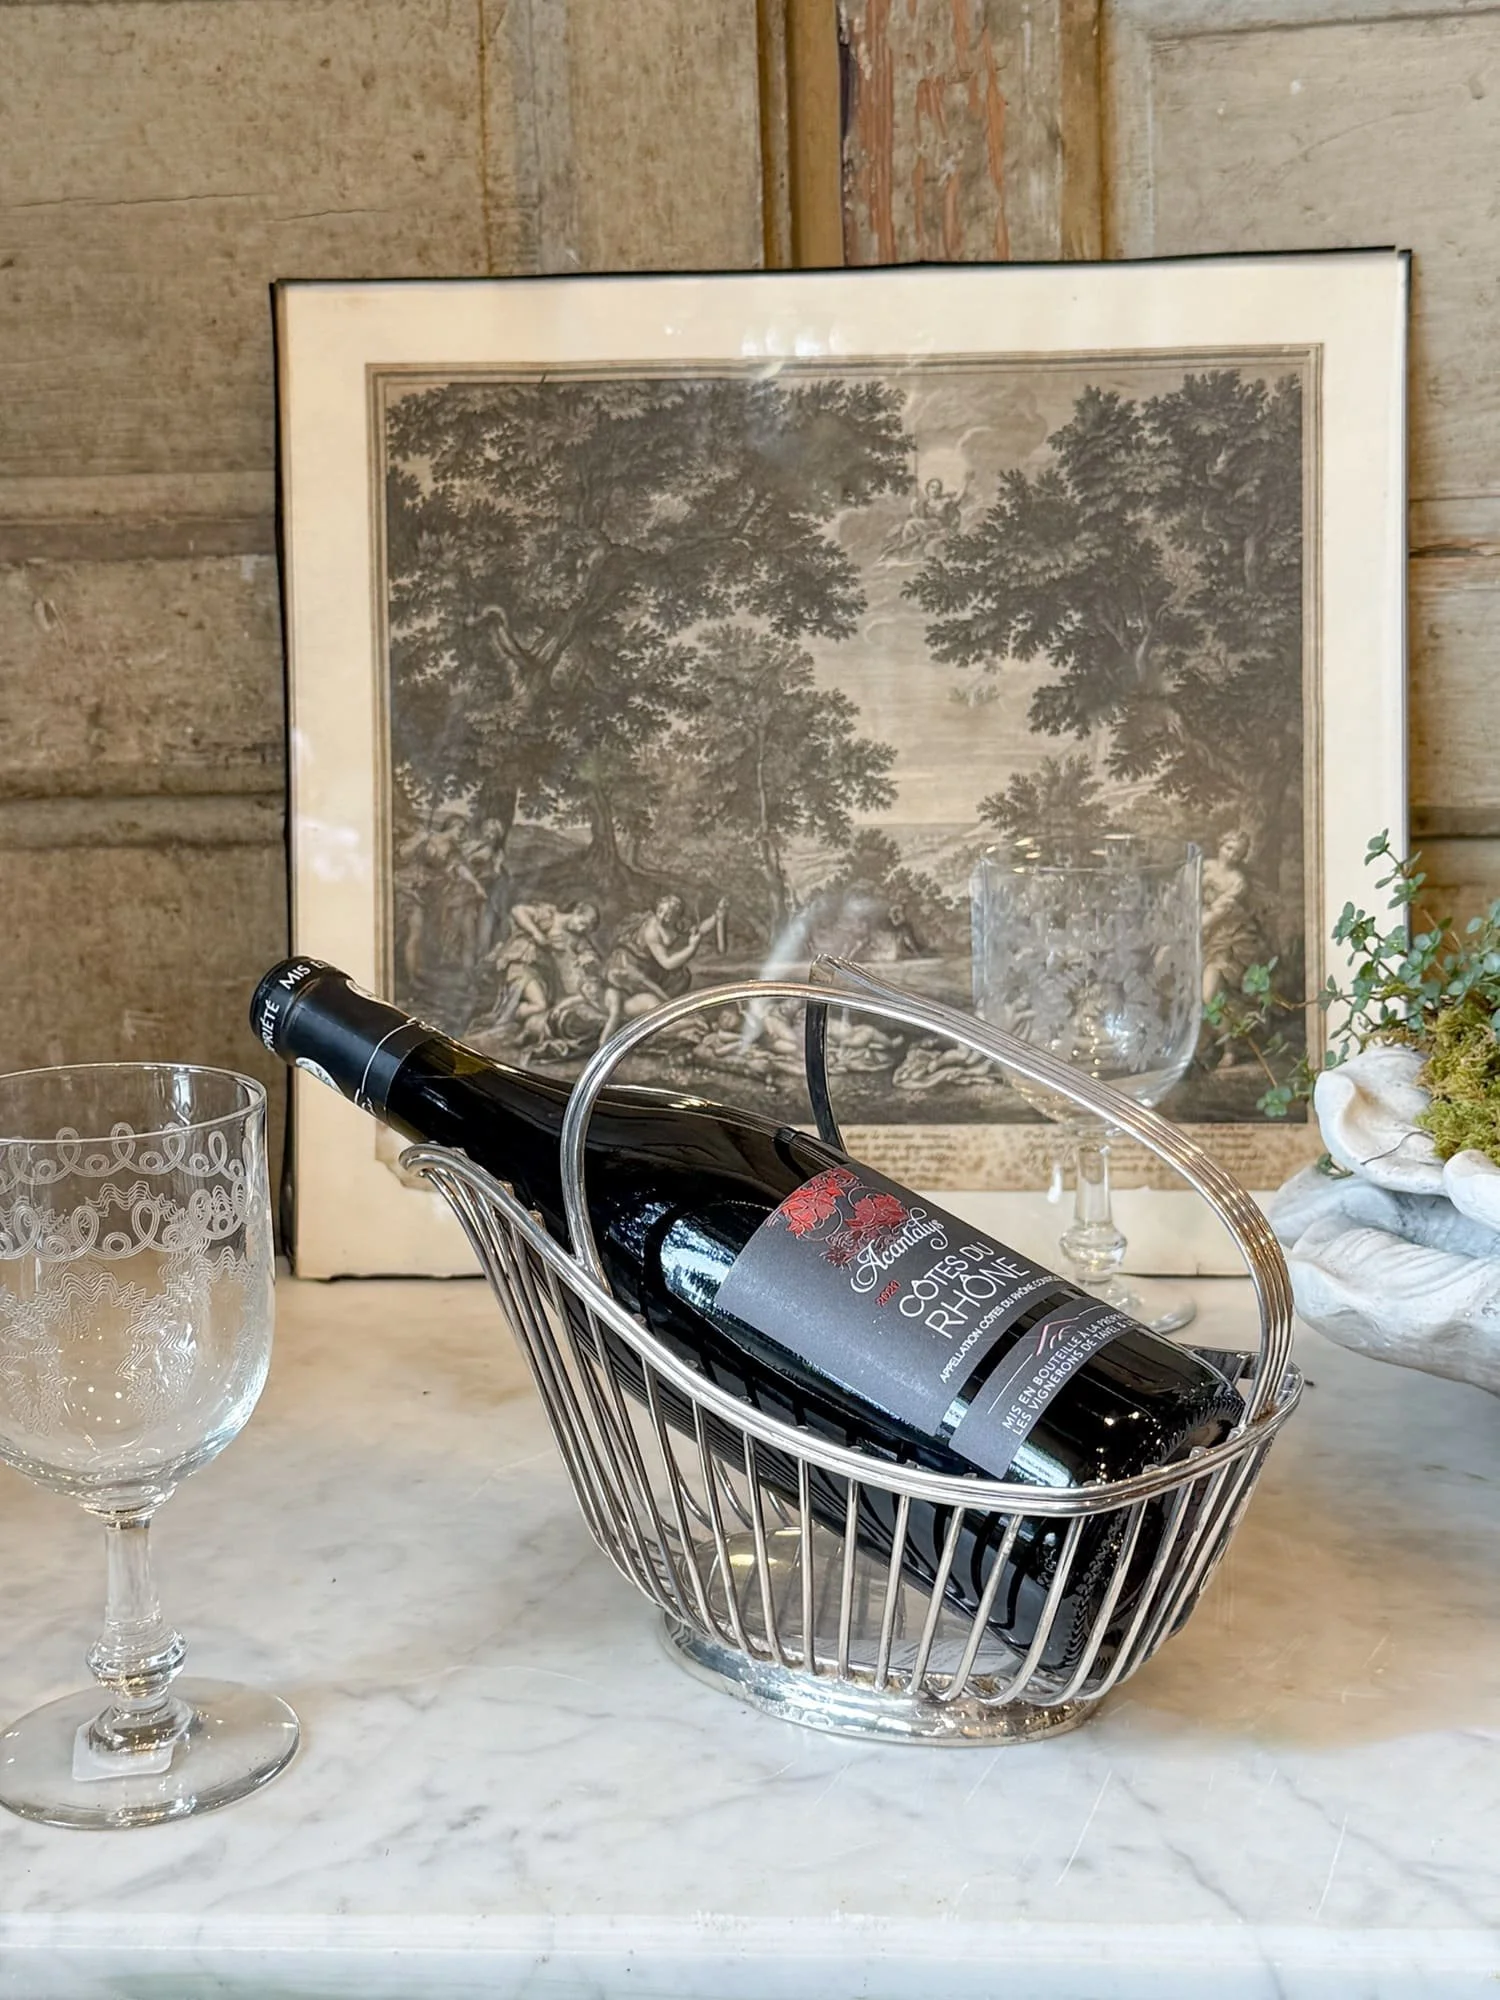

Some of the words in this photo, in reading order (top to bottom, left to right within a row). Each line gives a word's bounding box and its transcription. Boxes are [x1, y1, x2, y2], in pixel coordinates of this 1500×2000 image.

[279, 964, 311, 990] MIS
[851, 1207, 949, 1293] Acantalys
[899, 1255, 969, 1318] CÔTES
[959, 1242, 995, 1262] DU
[925, 1256, 1031, 1339] RHÔNE
[939, 1328, 984, 1384] APPELLATION
[979, 1304, 1005, 1330] CÔTES
[1000, 1296, 1015, 1309] DU
[1001, 1404, 1022, 1430] MIS
[1018, 1385, 1037, 1405] EN
[1032, 1335, 1082, 1386] BOUTEILLE
[1086, 1323, 1102, 1334] LA
[1012, 1414, 1033, 1436] LES
[1028, 1351, 1084, 1411] VIGNERONS
[1080, 1338, 1098, 1352] DE
